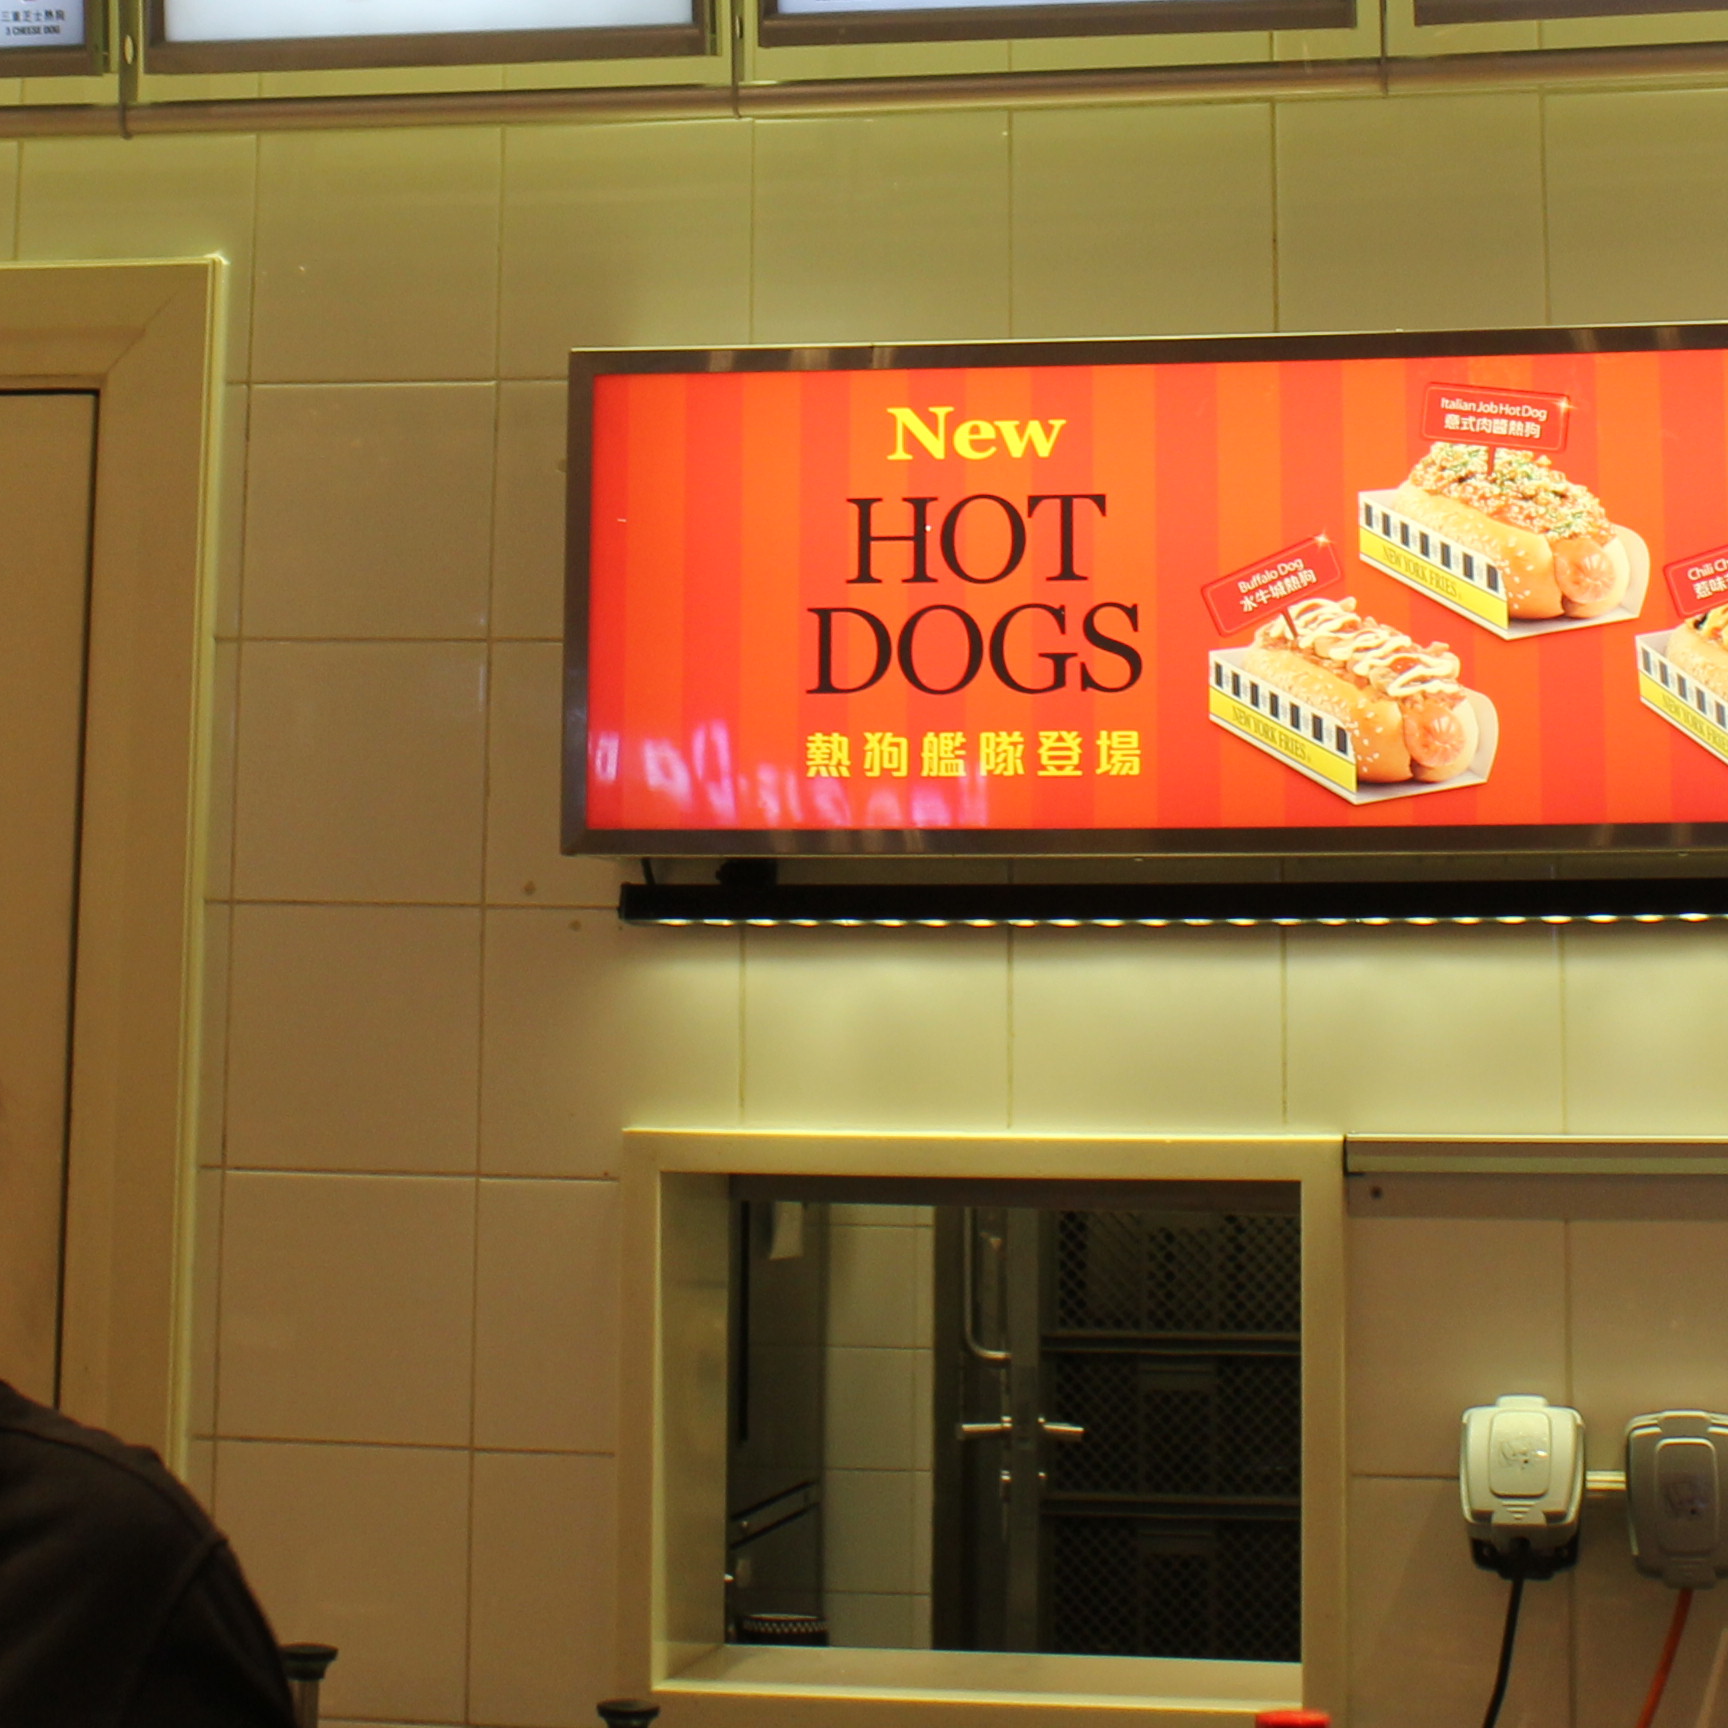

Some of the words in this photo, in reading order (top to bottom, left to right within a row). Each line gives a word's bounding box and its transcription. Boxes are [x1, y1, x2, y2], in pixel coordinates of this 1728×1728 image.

[1441, 397, 1476, 411] Italian
[1477, 401, 1498, 414] Job
[1499, 403, 1521, 416] Hot
[1522, 405, 1548, 422] Dog
[888, 407, 1065, 462] New
[846, 494, 1108, 584] HOT
[1238, 569, 1278, 593] Buffalo
[1277, 558, 1304, 576] Dog
[1240, 569, 1318, 612] 水牛城熱狗
[1687, 563, 1715, 580] Chili
[805, 601, 1143, 695] DOGS
[805, 729, 1141, 779] 熱狗艦隊登場
